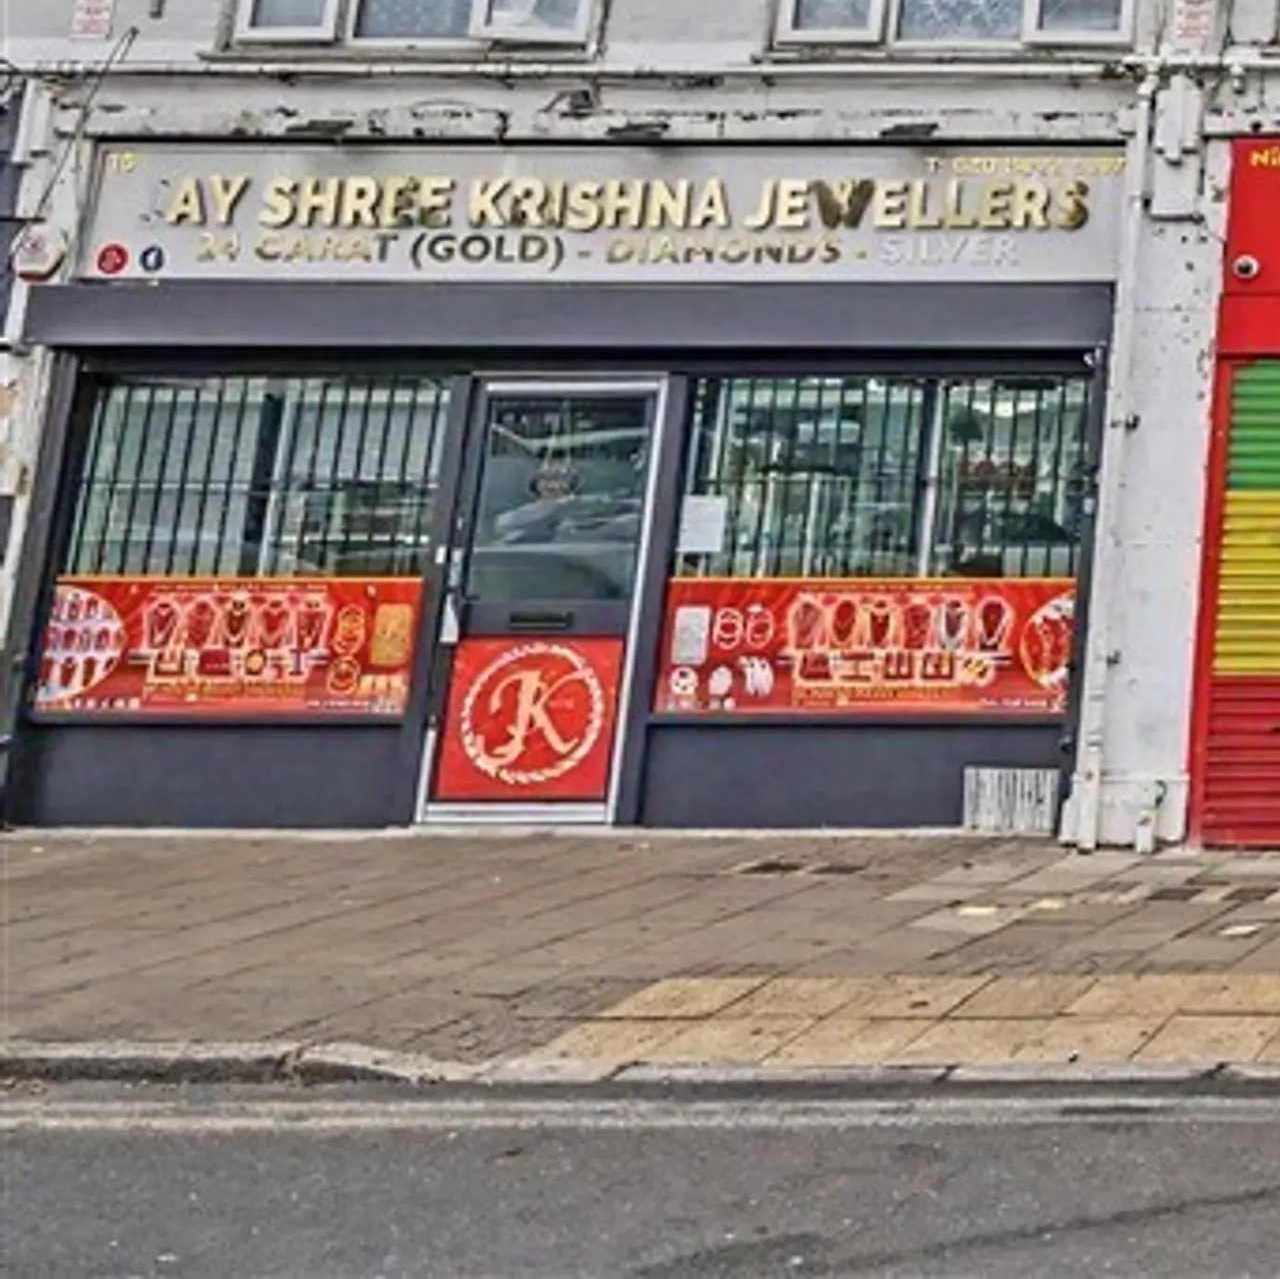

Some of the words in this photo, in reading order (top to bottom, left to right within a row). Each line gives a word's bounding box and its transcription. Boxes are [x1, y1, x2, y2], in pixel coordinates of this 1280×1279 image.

[138, 177, 251, 226] AY
[258, 176, 455, 228] SHREE
[469, 176, 731, 231] KRISHNA
[743, 178, 1090, 232] JEWELLERS
[255, 233, 399, 263] CARAT
[409, 233, 565, 274] (GOLD)
[604, 236, 842, 265] DIAMONDS
[880, 236, 1021, 267] SILVER
